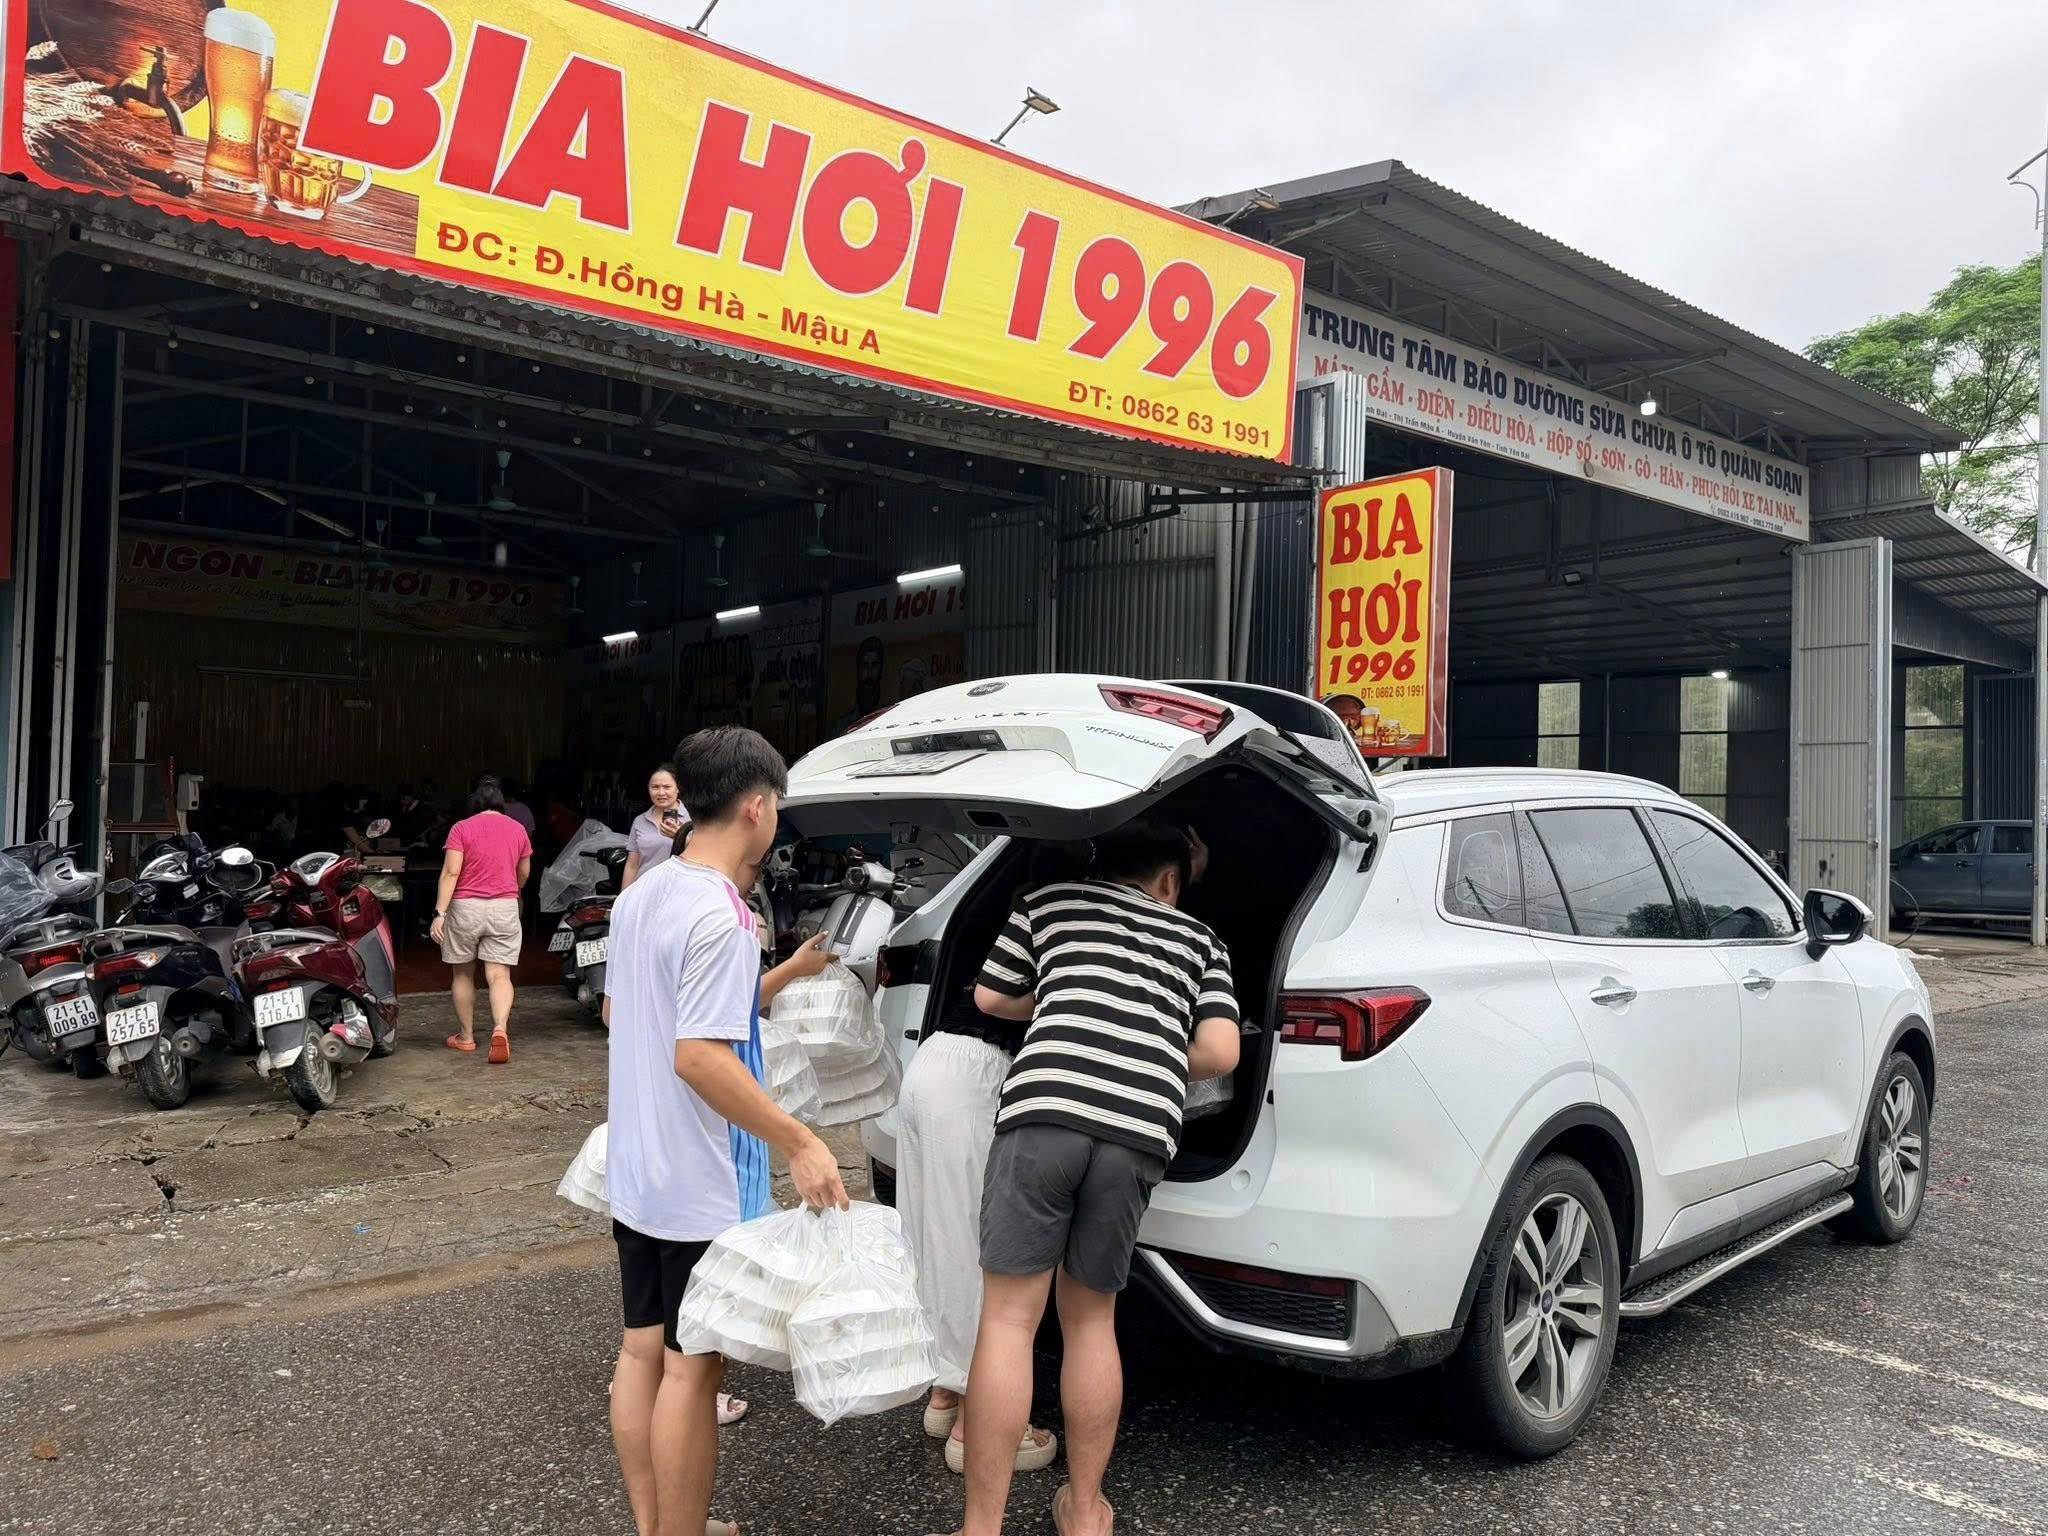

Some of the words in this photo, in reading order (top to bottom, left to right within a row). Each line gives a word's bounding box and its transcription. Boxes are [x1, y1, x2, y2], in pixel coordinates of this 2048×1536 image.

[299, 0, 630, 233] BIA
[674, 97, 966, 317] HƠI
[1005, 208, 1281, 400] 1996
[436, 221, 518, 266] ĐC:
[534, 247, 685, 312] Đ.Hồng
[697, 284, 745, 322] Hà
[780, 306, 849, 348] Mậu
[857, 328, 881, 355] A
[1068, 380, 1114, 412] ĐT:
[1121, 394, 1180, 427] 0862
[1186, 410, 1215, 436] 63
[1222, 419, 1273, 450] 1991
[1304, 303, 1395, 363] TRUNG
[1402, 339, 1458, 384] TÂM
[1463, 358, 1508, 400] BẢO
[1590, 401, 1627, 440] SỬA
[1681, 432, 1692, 461] Ô
[1696, 440, 1717, 469] TÔ
[1765, 463, 1803, 497] SOẠN
[1314, 353, 1354, 377] MÁ
[1417, 388, 1455, 423] ĐIỆN
[1506, 416, 1536, 446] HÒA
[1546, 428, 1573, 461] HỘP
[1601, 446, 1626, 472] SƠN
[1692, 475, 1720, 504] PHỤC
[1742, 490, 1755, 512] XE
[1757, 495, 1774, 517] TAI
[1329, 492, 1423, 566] BIA
[130, 541, 264, 580] NGON
[854, 597, 889, 626] BIA
[893, 585, 938, 621] HƠI
[1326, 568, 1423, 650] HƠI
[1328, 649, 1417, 685] 1996
[1360, 687, 1374, 699] ĐT:
[1375, 686, 1394, 698] 0862
[1395, 685, 1405, 698] 63
[1407, 684, 1425, 697] 1991
[53, 999, 89, 1020] 21-E1
[115, 1006, 150, 1027] 21-E1
[259, 1003, 301, 1025] 316.41
[262, 990, 295, 1010] 21-E1
